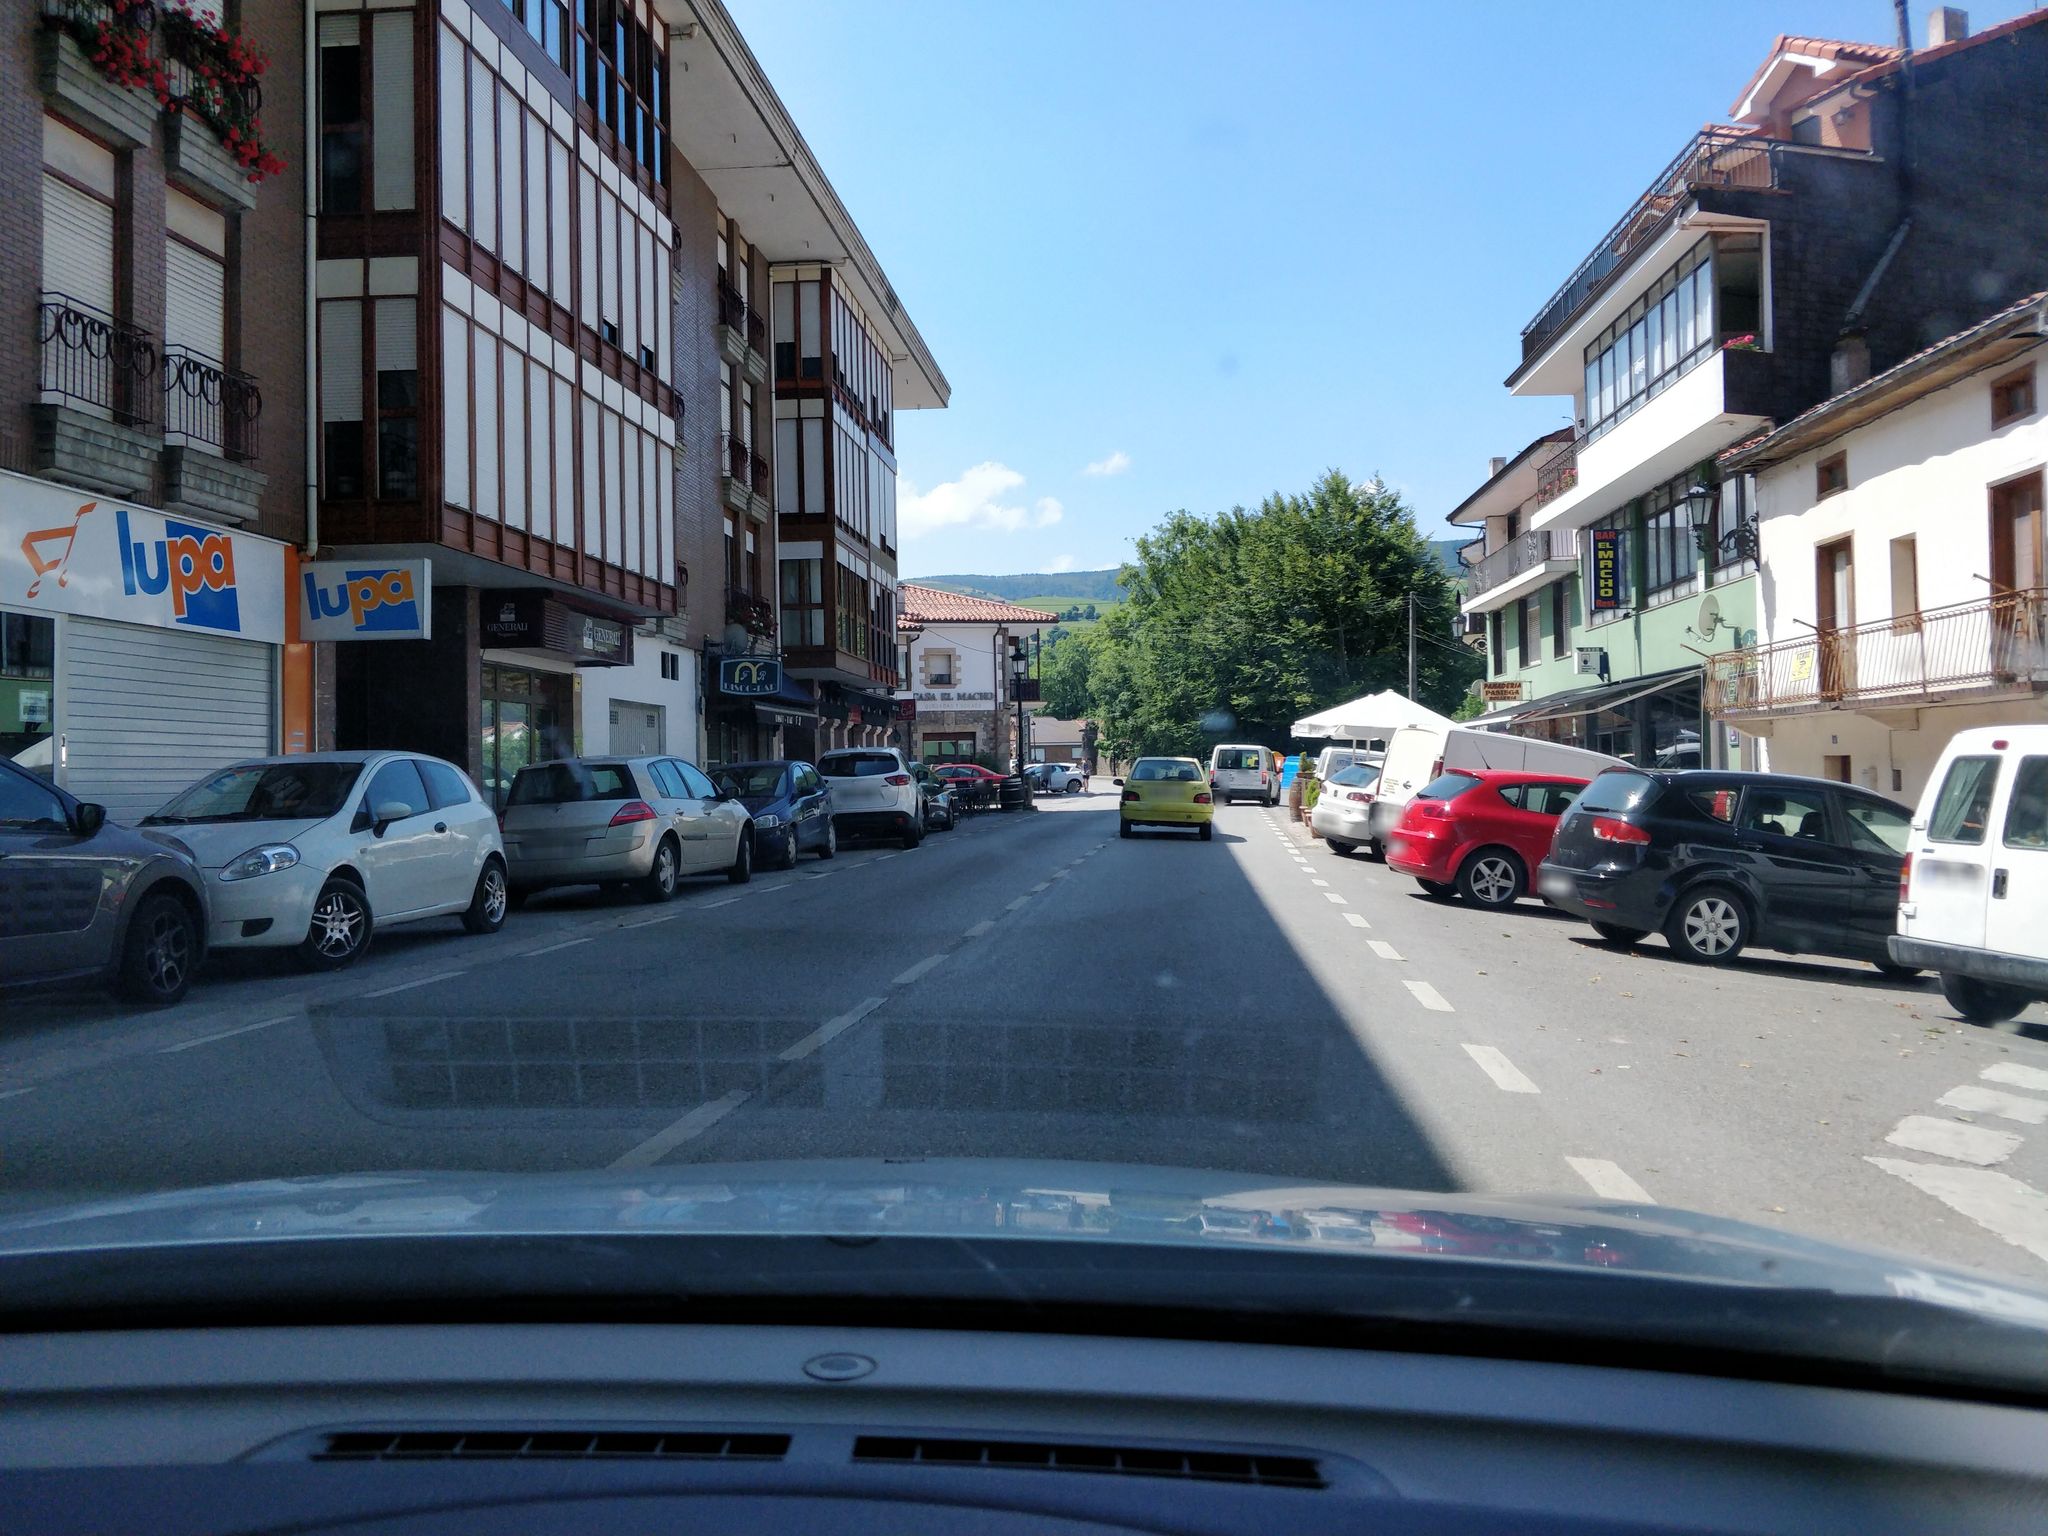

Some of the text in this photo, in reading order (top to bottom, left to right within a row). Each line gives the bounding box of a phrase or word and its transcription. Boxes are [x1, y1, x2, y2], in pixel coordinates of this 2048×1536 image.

[1595, 531, 1616, 540] BAR
[116, 511, 237, 617] lupa
[1598, 550, 1614, 597] MACHO
[304, 569, 414, 626] lupa
[487, 623, 528, 632] GENERALI
[593, 627, 621, 646] GENERALI
